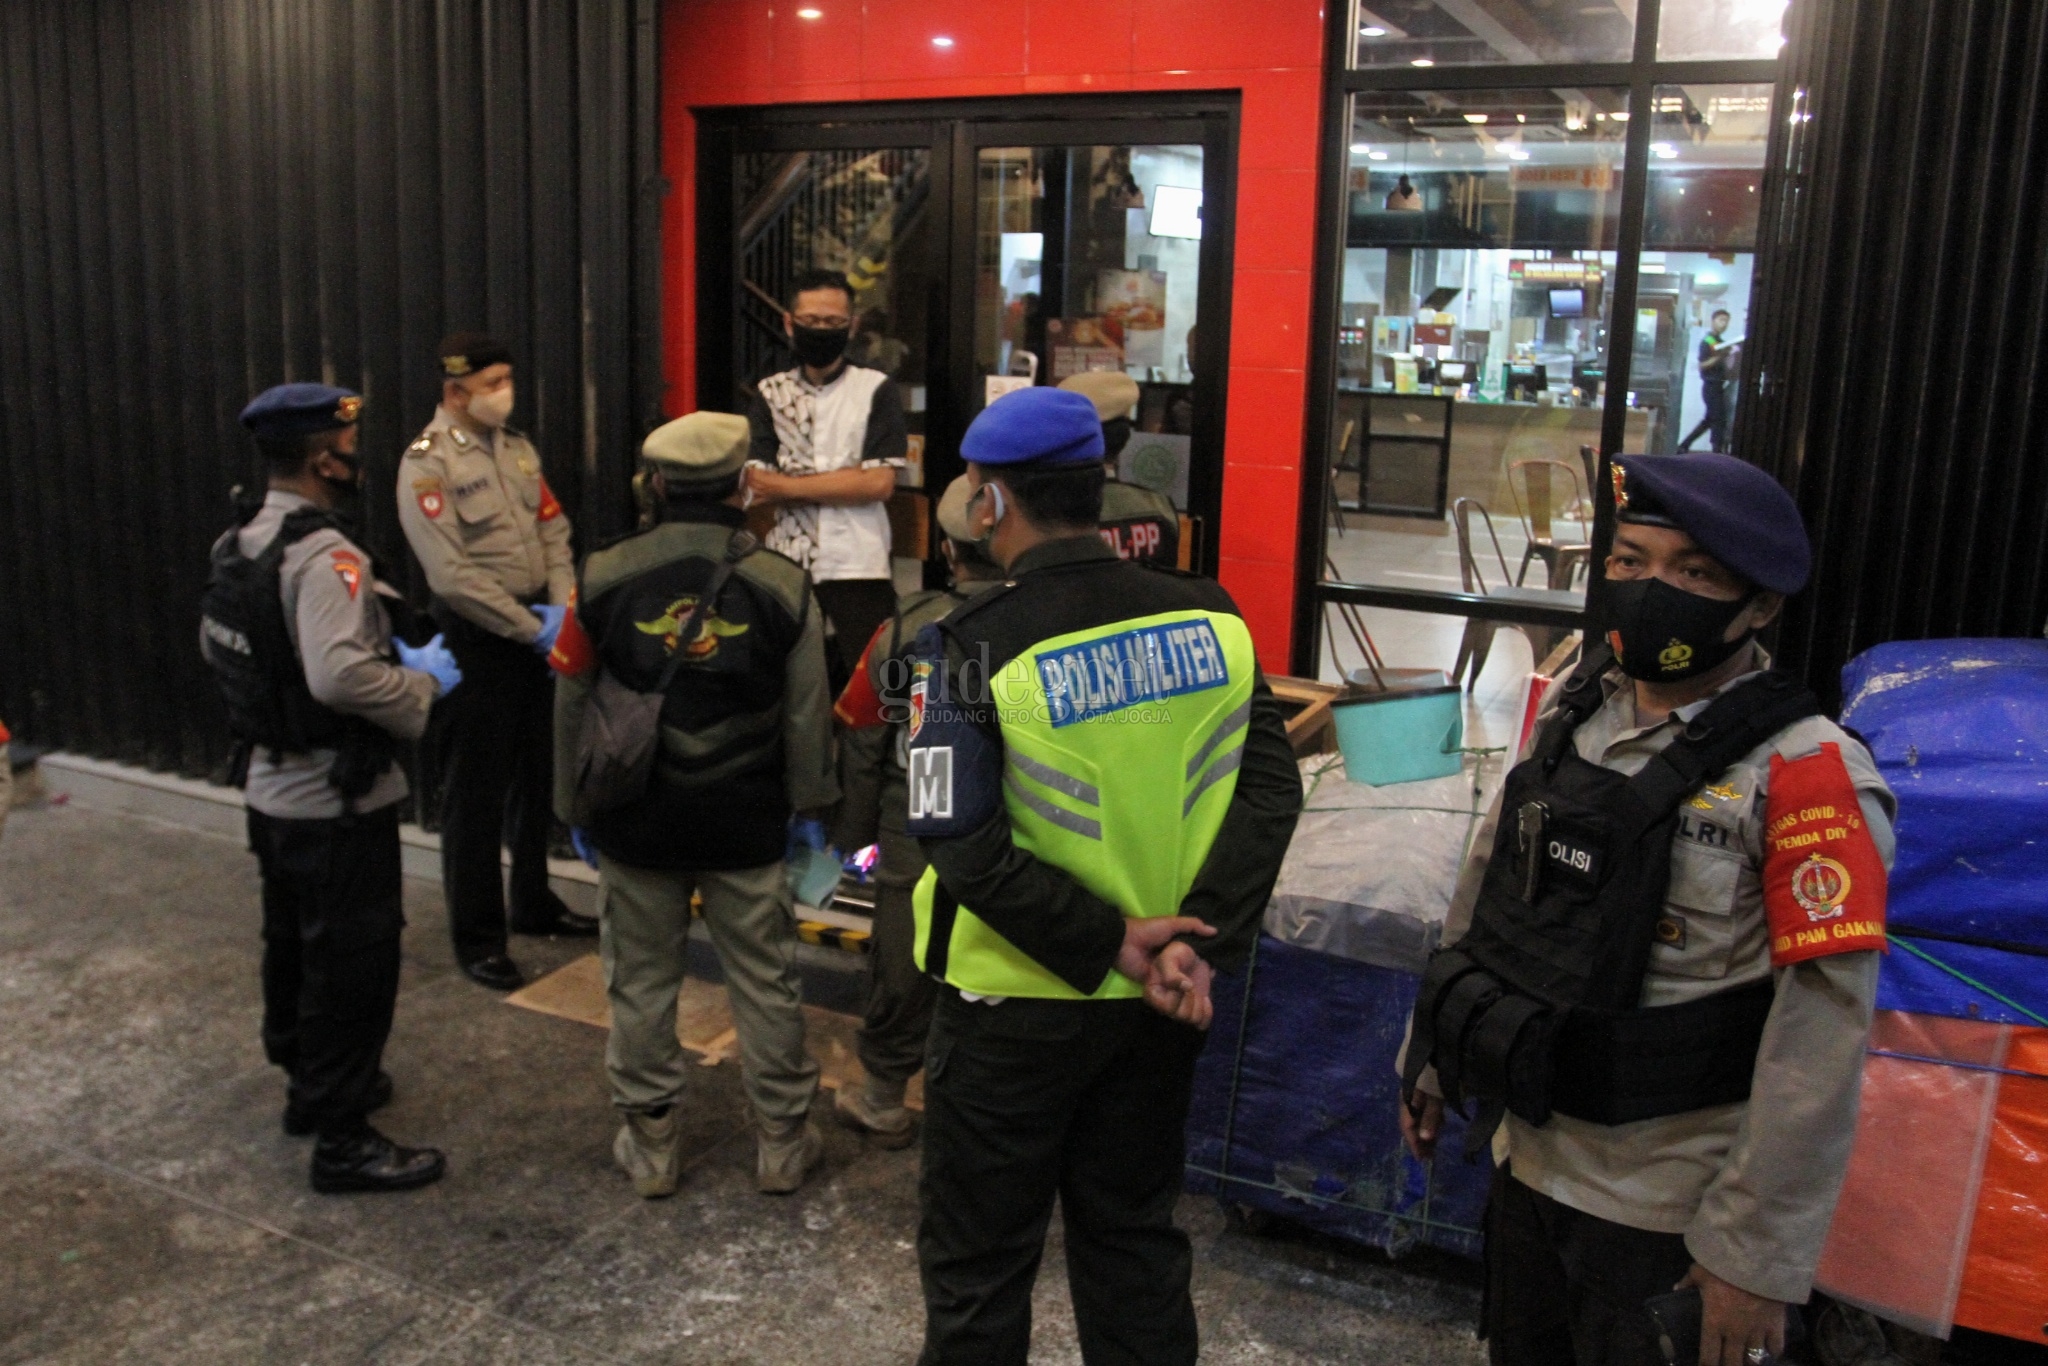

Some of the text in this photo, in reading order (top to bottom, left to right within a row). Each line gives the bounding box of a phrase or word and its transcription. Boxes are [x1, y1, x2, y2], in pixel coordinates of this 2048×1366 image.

[1043, 625, 1223, 718] POLISI MILITER
[908, 746, 953, 819] M
[1800, 806, 1835, 822] COVID
[1846, 814, 1860, 829] 19
[1775, 827, 1848, 852] PEMDA DIY
[1549, 840, 1592, 873] OLISI
[1795, 926, 1827, 947] PAM
